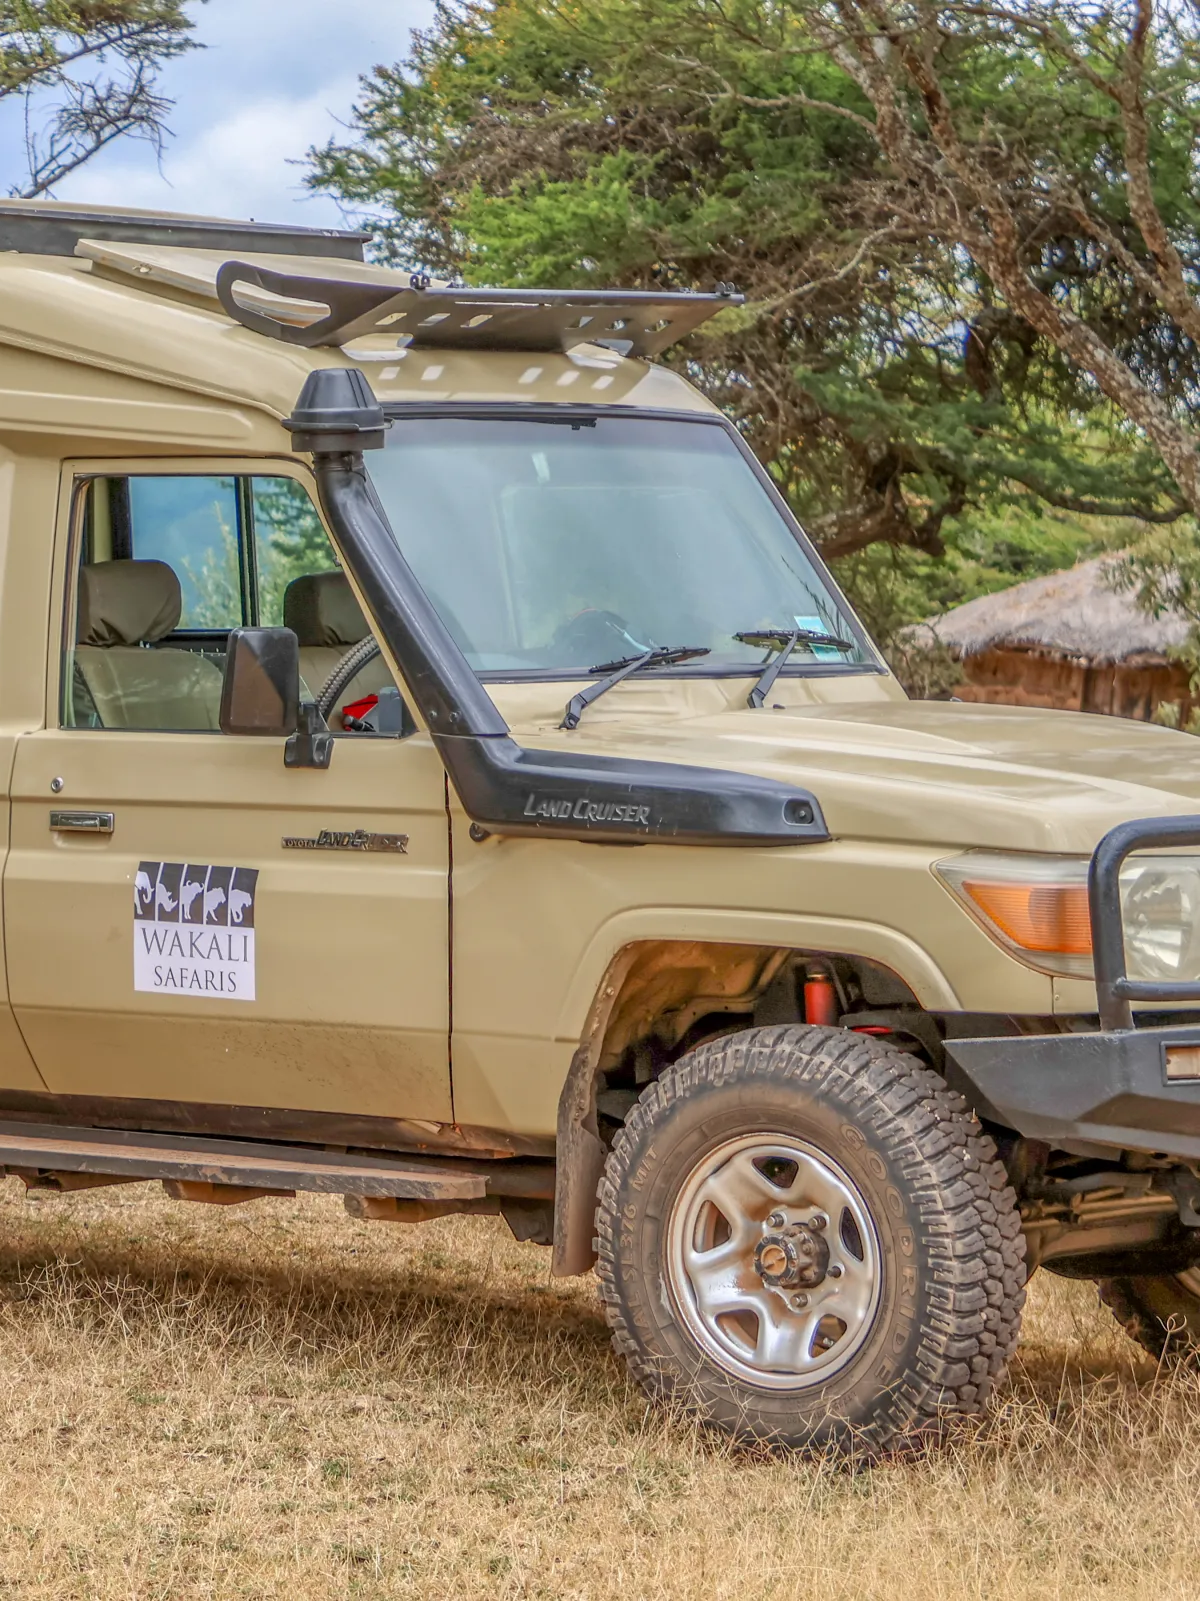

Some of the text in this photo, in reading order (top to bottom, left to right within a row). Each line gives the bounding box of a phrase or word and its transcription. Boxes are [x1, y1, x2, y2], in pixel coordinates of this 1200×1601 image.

[572, 798, 649, 825] CRUISER
[141, 927, 250, 963] WAKALI
[153, 965, 238, 993] SAFARIS
[617, 1200, 639, 1284] SL376
[631, 1143, 659, 1192] M/T
[840, 1122, 918, 1384] GOODRIDE
